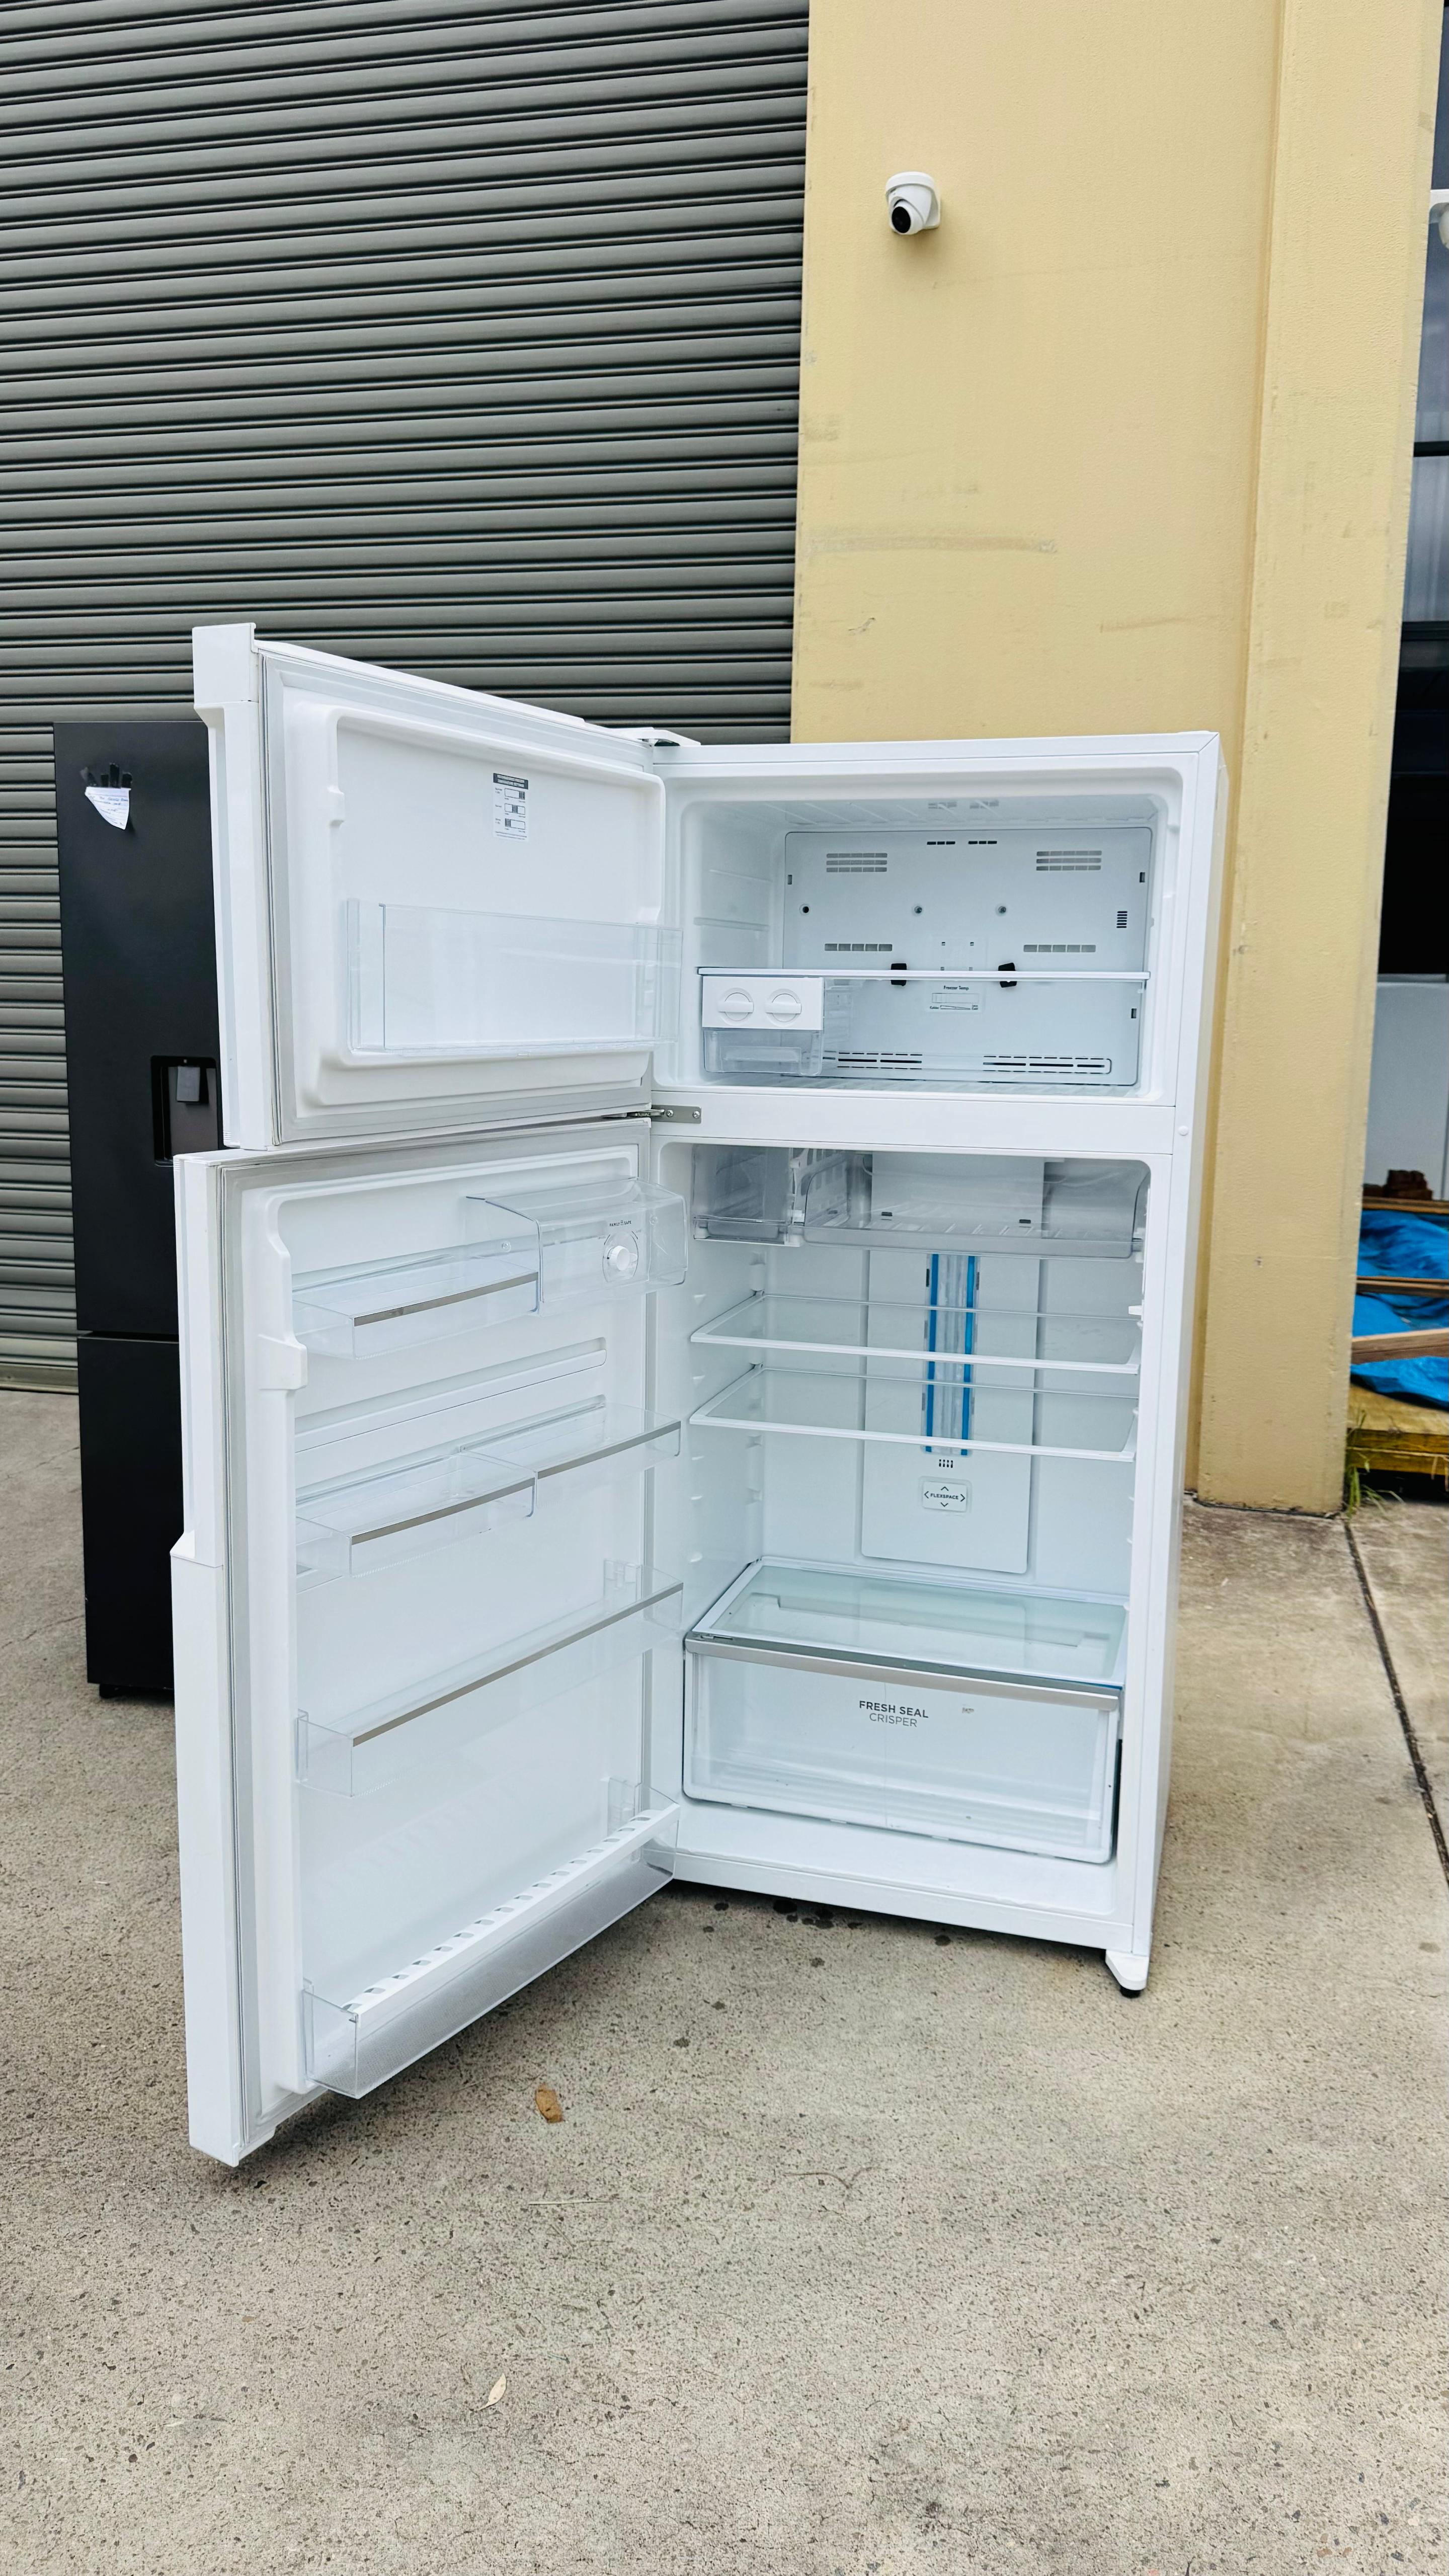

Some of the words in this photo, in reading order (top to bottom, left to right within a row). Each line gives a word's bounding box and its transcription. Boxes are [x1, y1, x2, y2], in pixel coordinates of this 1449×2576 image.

[859, 1700, 896, 1714] FRESH
[899, 1706, 929, 1718] SEAL
[869, 1713, 918, 1728] CRISPER
